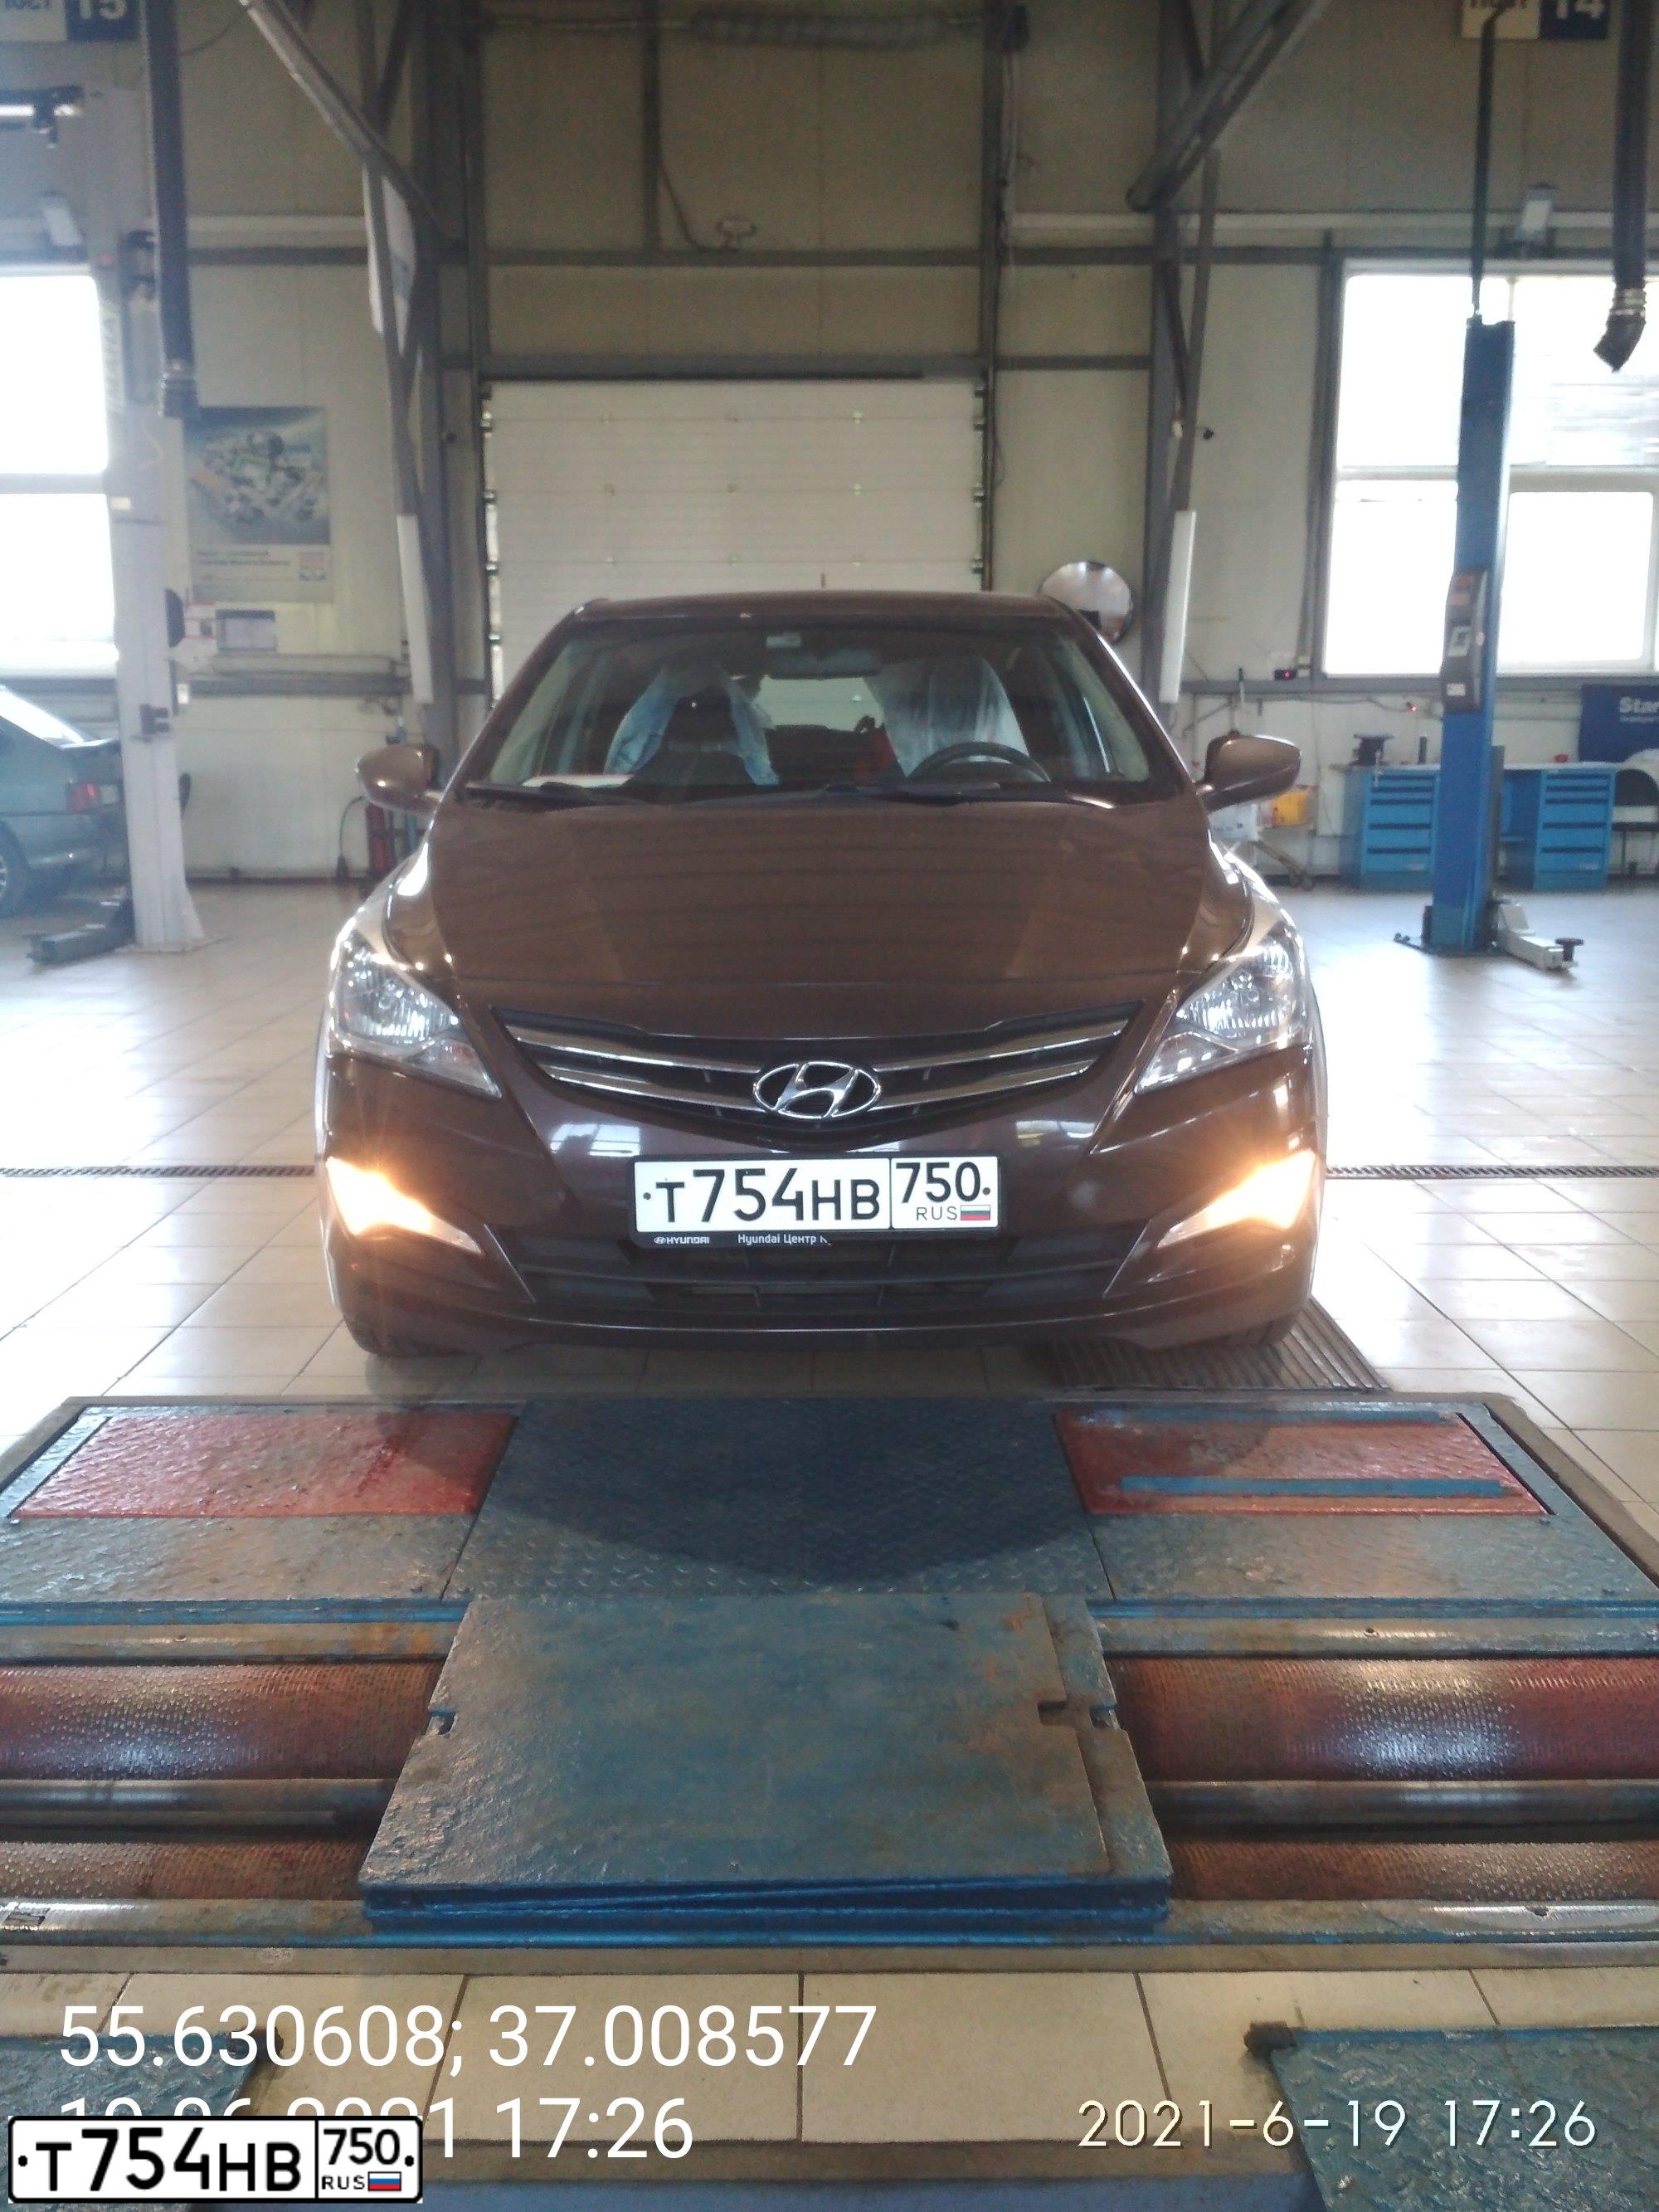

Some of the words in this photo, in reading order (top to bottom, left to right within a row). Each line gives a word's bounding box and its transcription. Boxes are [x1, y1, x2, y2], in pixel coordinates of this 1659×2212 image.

[896, 1162, 982, 1204] 750
[916, 1206, 958, 1221] RUS
[666, 1235, 710, 1245] HYUNDAI
[737, 1233, 781, 1246] Hyundai
[783, 1234, 817, 1245] Центр
